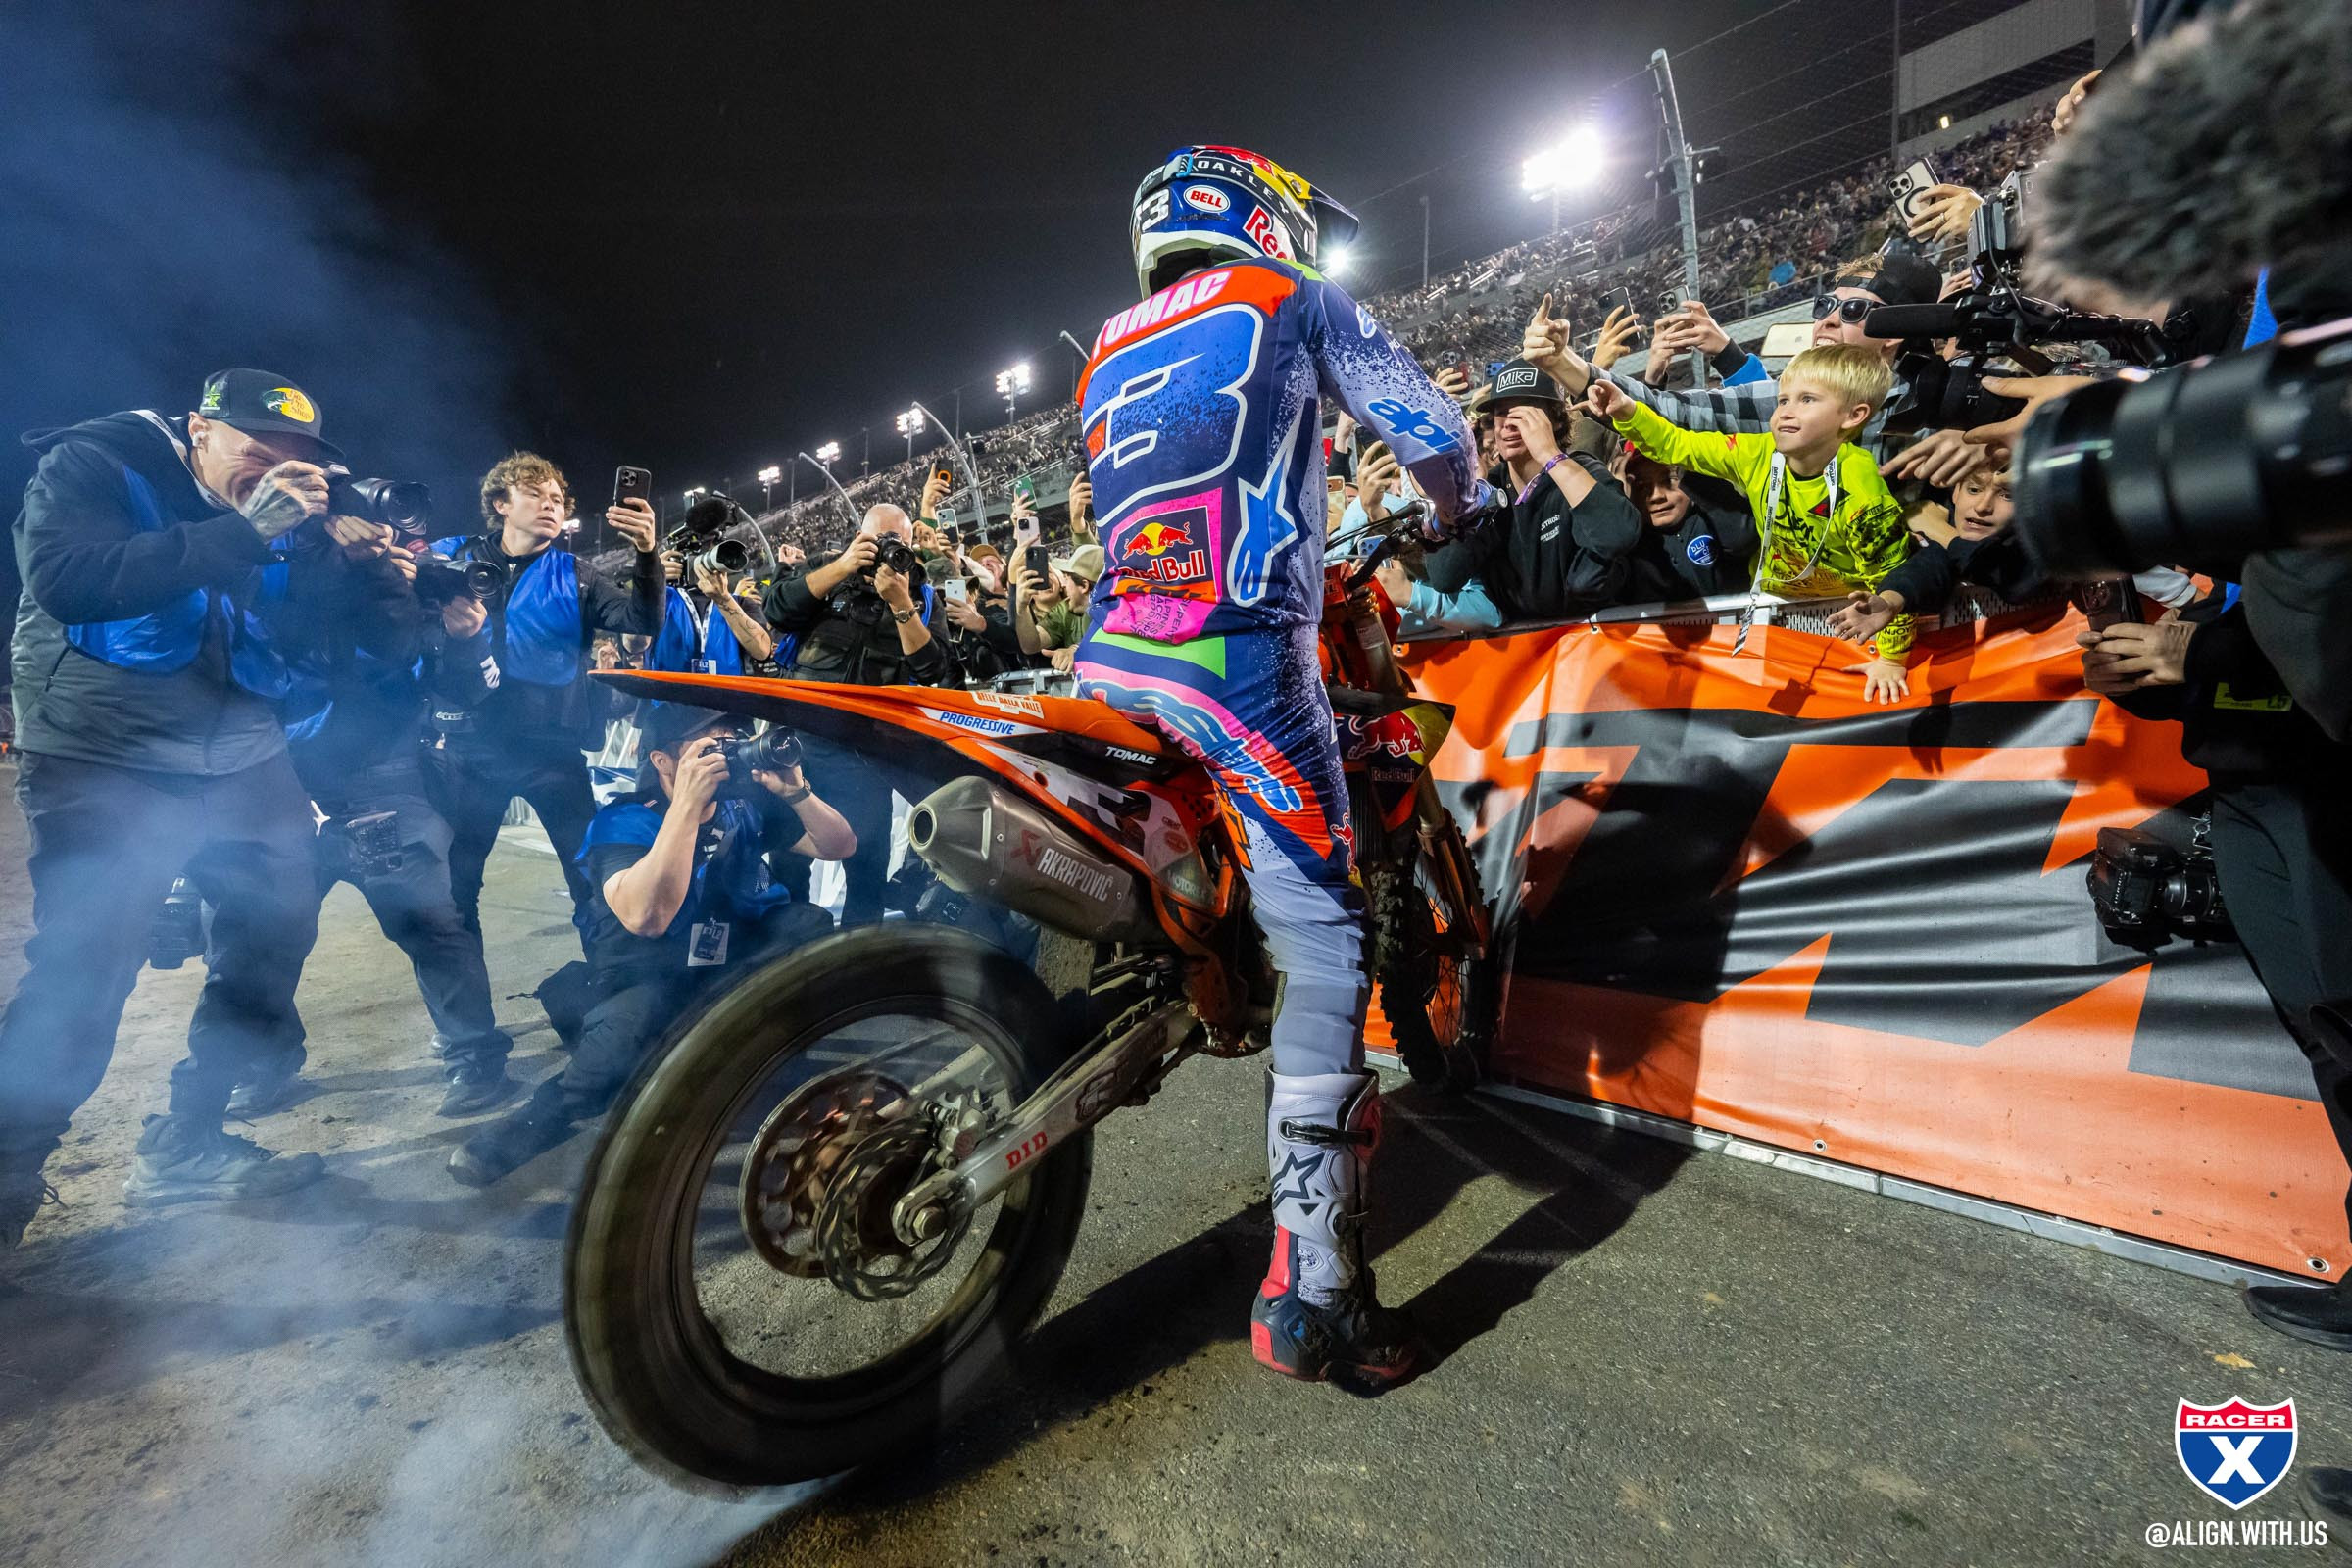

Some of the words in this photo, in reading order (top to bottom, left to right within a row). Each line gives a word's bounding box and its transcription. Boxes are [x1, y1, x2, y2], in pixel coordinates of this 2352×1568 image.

[1189, 189, 1224, 209] BELL
[1197, 159, 1290, 214] OAKLEY
[1244, 205, 1293, 261] Re
[1094, 270, 1232, 360] TOMAC
[1160, 549, 1206, 582] Bull
[939, 711, 1016, 735] PROGRESSIVE
[1104, 745, 1157, 766] TOMAC
